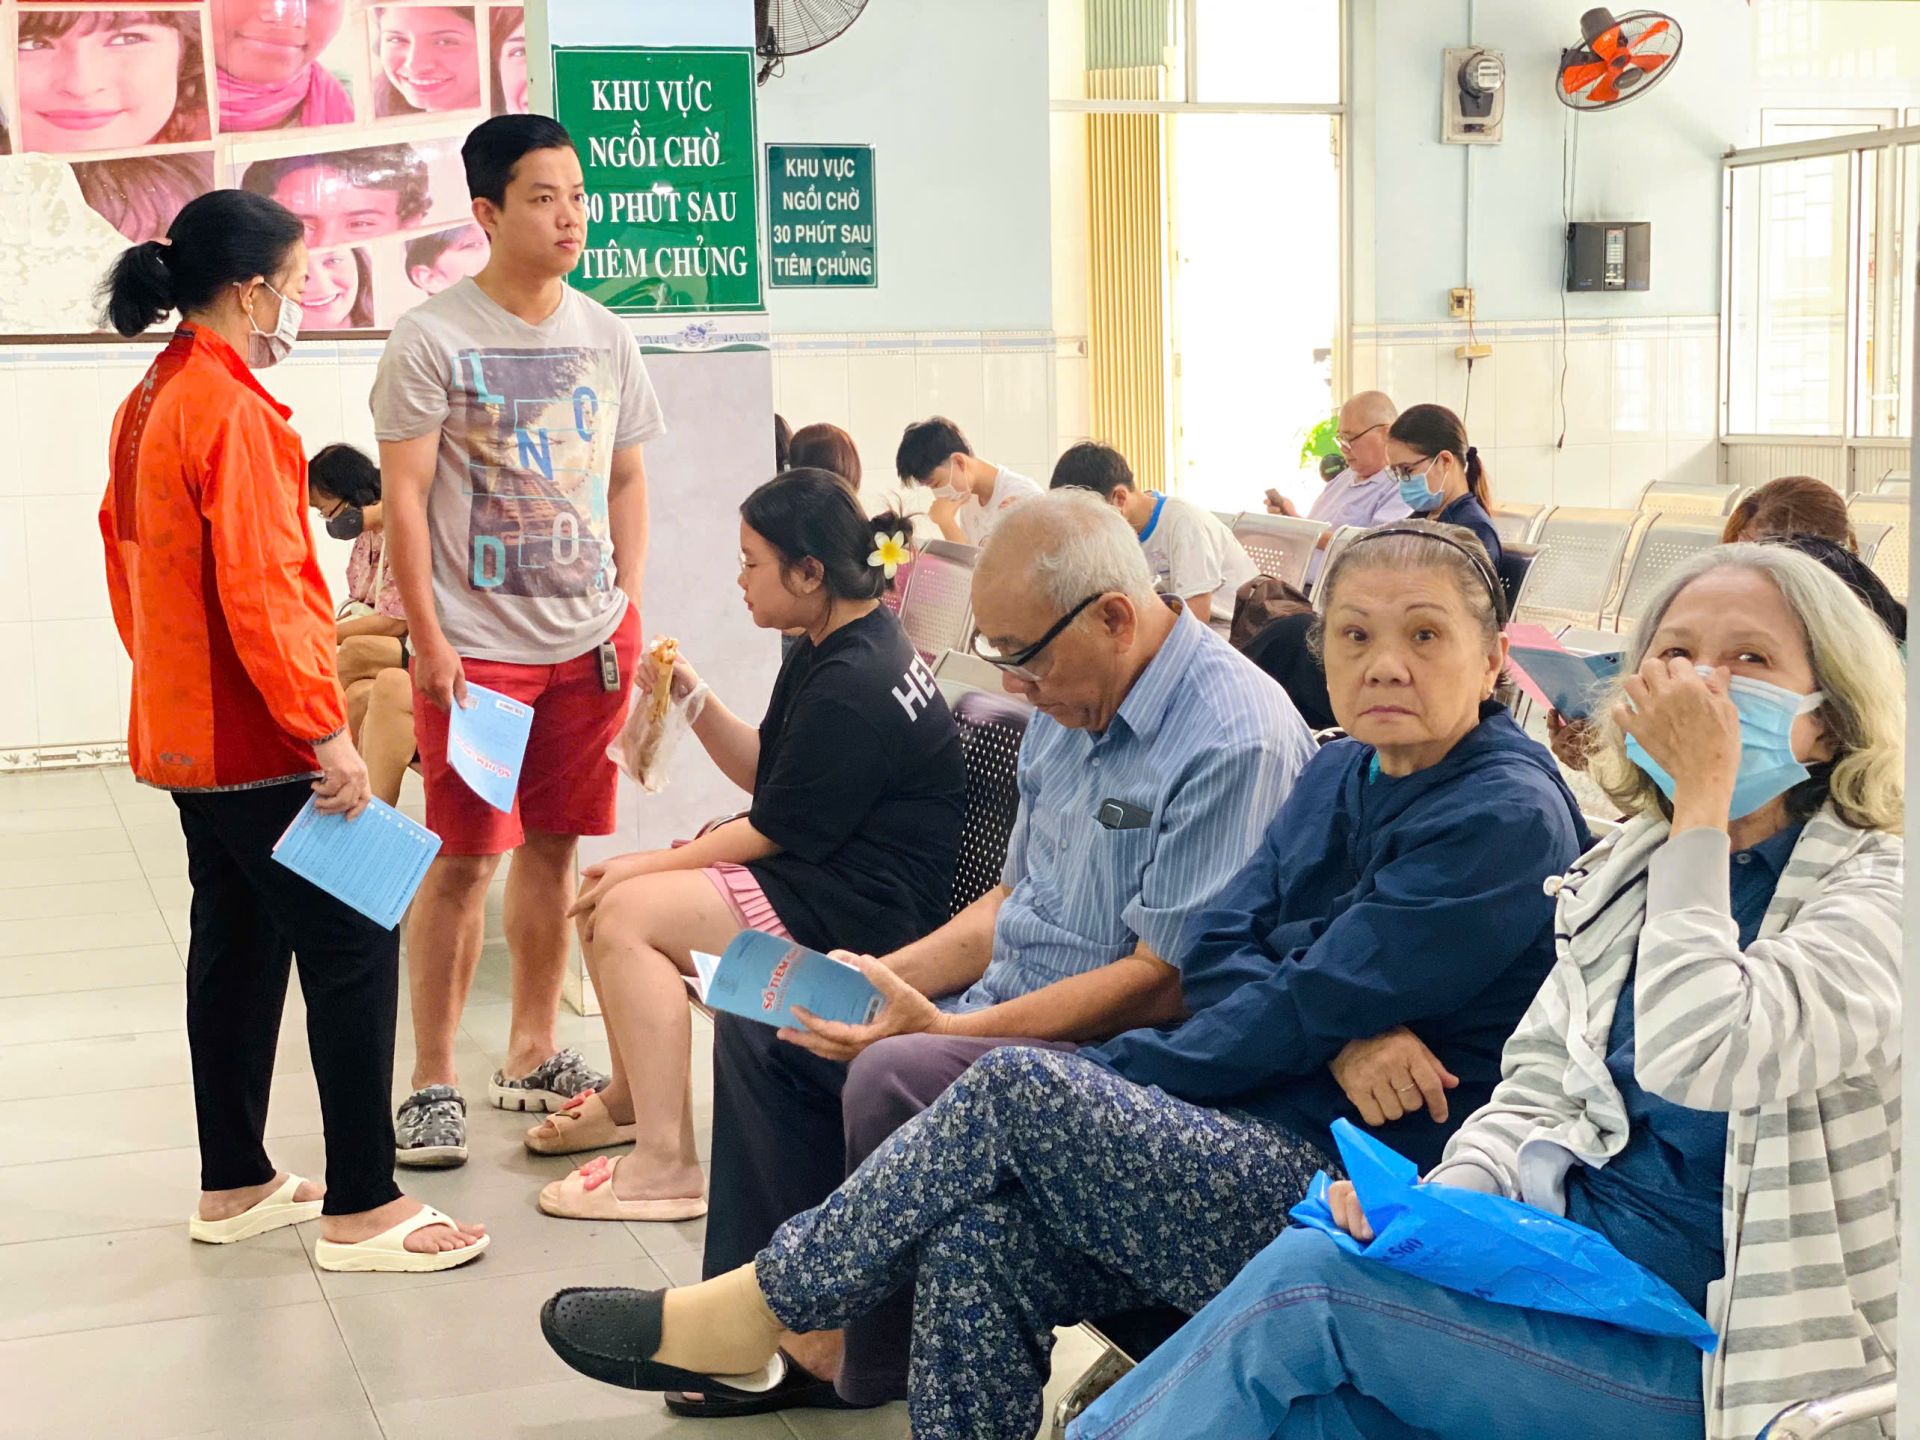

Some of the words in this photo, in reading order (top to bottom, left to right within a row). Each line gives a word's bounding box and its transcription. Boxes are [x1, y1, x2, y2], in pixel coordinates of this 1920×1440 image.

[591, 80, 649, 112] KHU
[656, 73, 713, 119] VỰC
[588, 119, 658, 167] NGỒI
[663, 126, 720, 167] CHỜ
[786, 158, 819, 178] KHU
[822, 156, 855, 181] VỰC
[688, 191, 736, 223] SAU
[782, 184, 822, 210] NGỒI
[825, 187, 860, 210] CHỜ
[773, 224, 791, 244] 30
[795, 219, 837, 243] PHÚT
[840, 224, 872, 244] SAU
[582, 238, 648, 279] TIÊM
[654, 234, 748, 277] CHỦNG
[774, 252, 812, 276] TIÊM
[816, 250, 872, 276] CHỦNG
[474, 535, 506, 587] D
